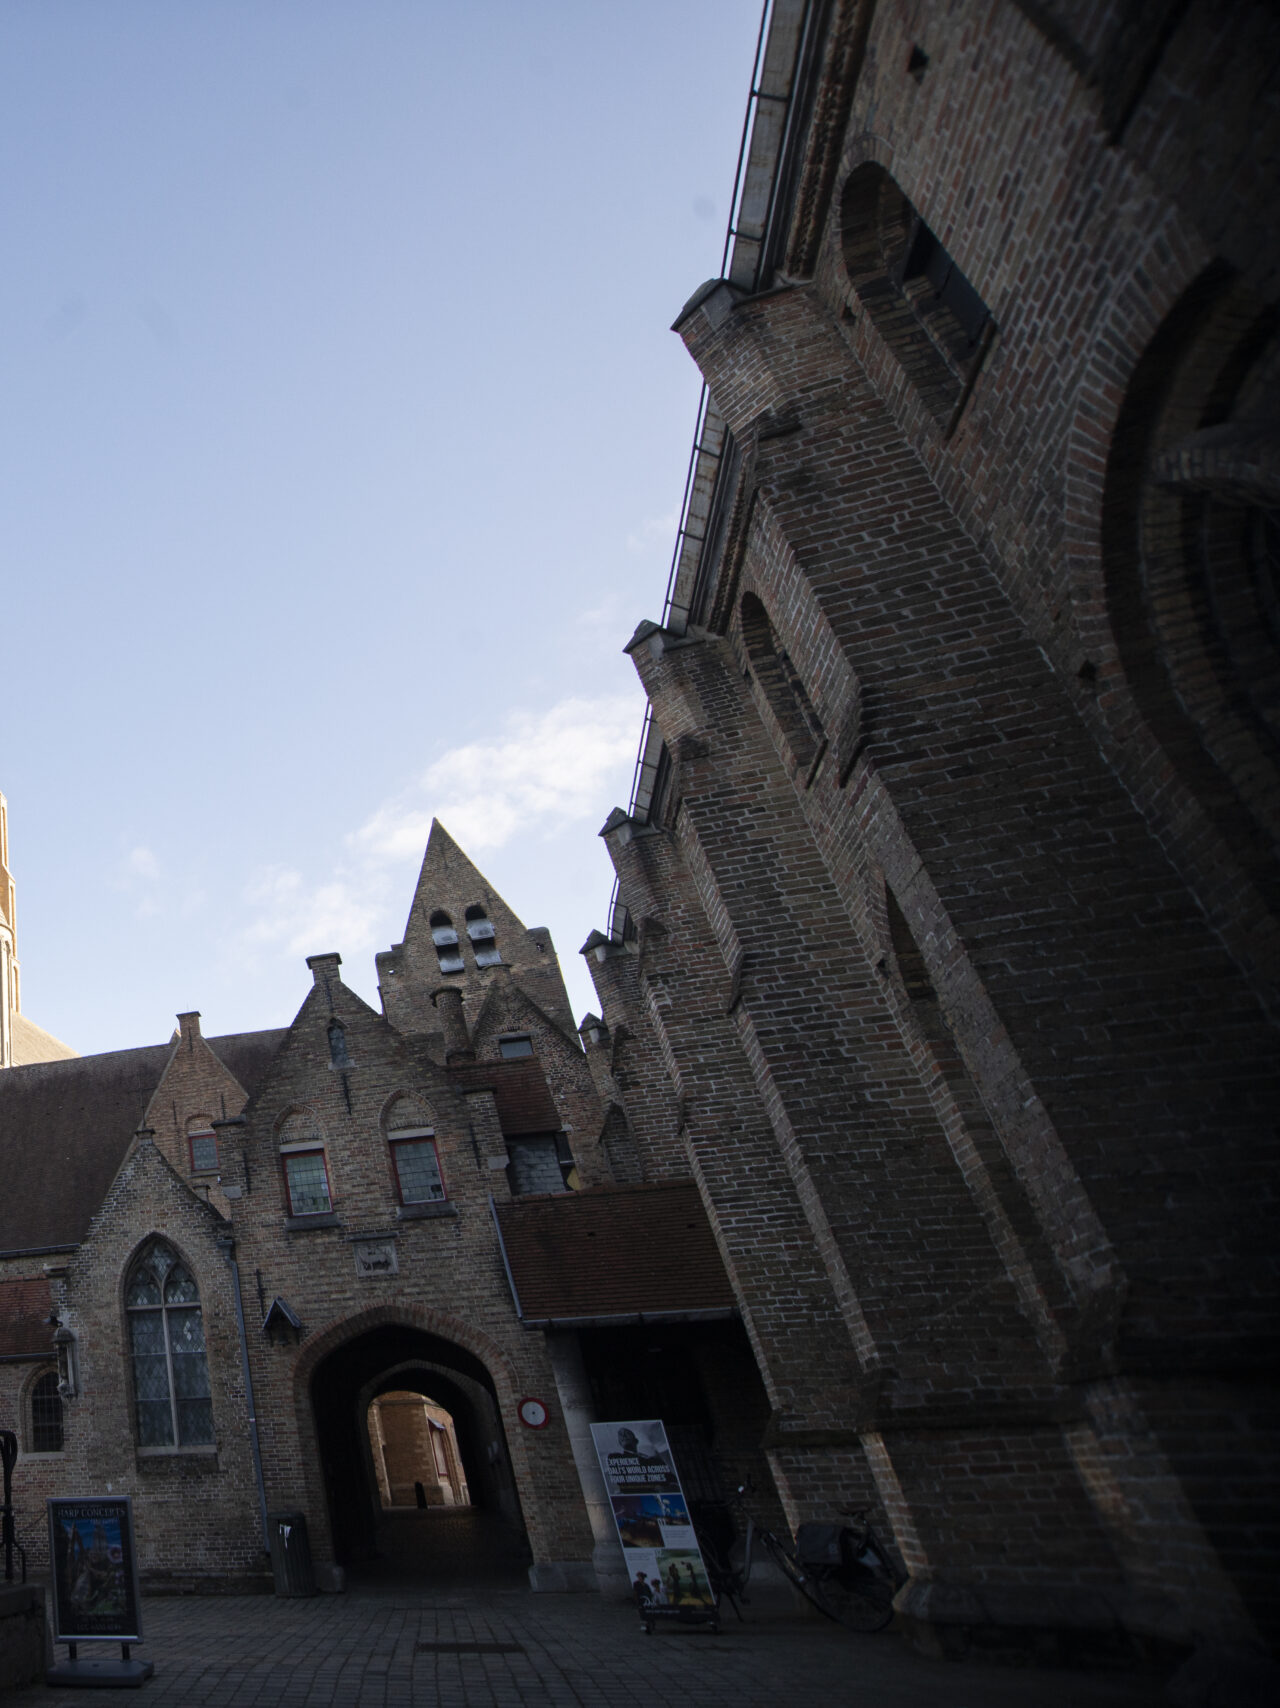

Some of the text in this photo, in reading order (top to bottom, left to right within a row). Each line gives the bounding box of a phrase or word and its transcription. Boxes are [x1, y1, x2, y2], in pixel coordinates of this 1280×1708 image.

[606, 1458, 640, 1466] EXPERIENCE
[626, 1465, 647, 1474] WORLD
[647, 1464, 671, 1473] ACROSS
[626, 1474, 647, 1483] UNIQUE
[647, 1473, 667, 1482] ZONES
[58, 1507, 126, 1518] HARP CONCERTS
